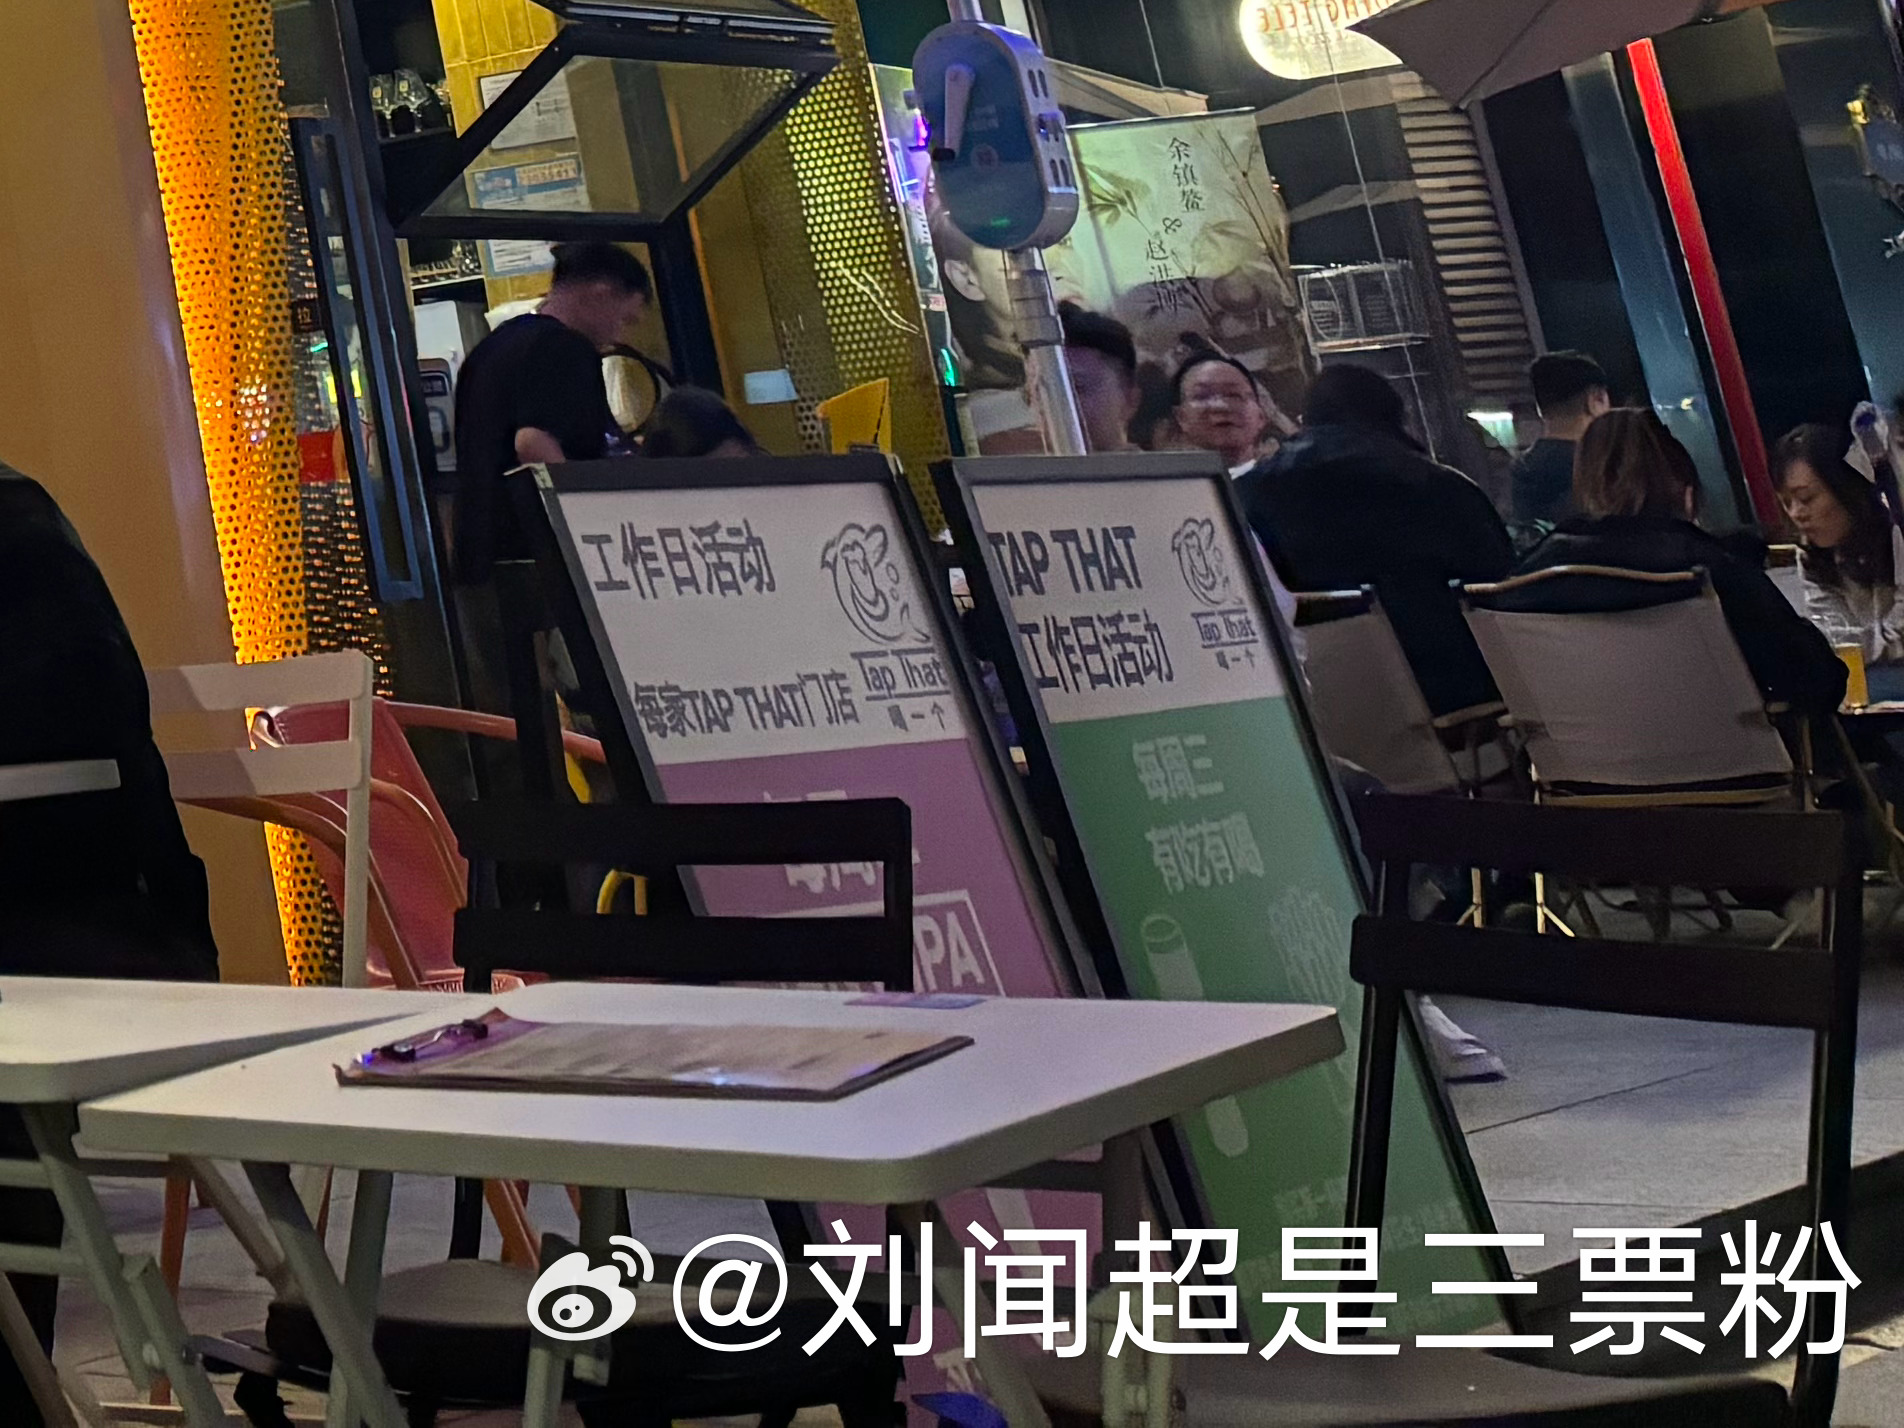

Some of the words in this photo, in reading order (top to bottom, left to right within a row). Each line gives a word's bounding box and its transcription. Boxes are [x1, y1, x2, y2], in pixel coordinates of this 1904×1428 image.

[581, 518, 776, 599] 工作日活动
[987, 530, 1049, 596] TAP
[1049, 525, 1142, 593] THAT
[1018, 608, 1174, 694] 工作日活动
[733, 667, 860, 731] THAT门店
